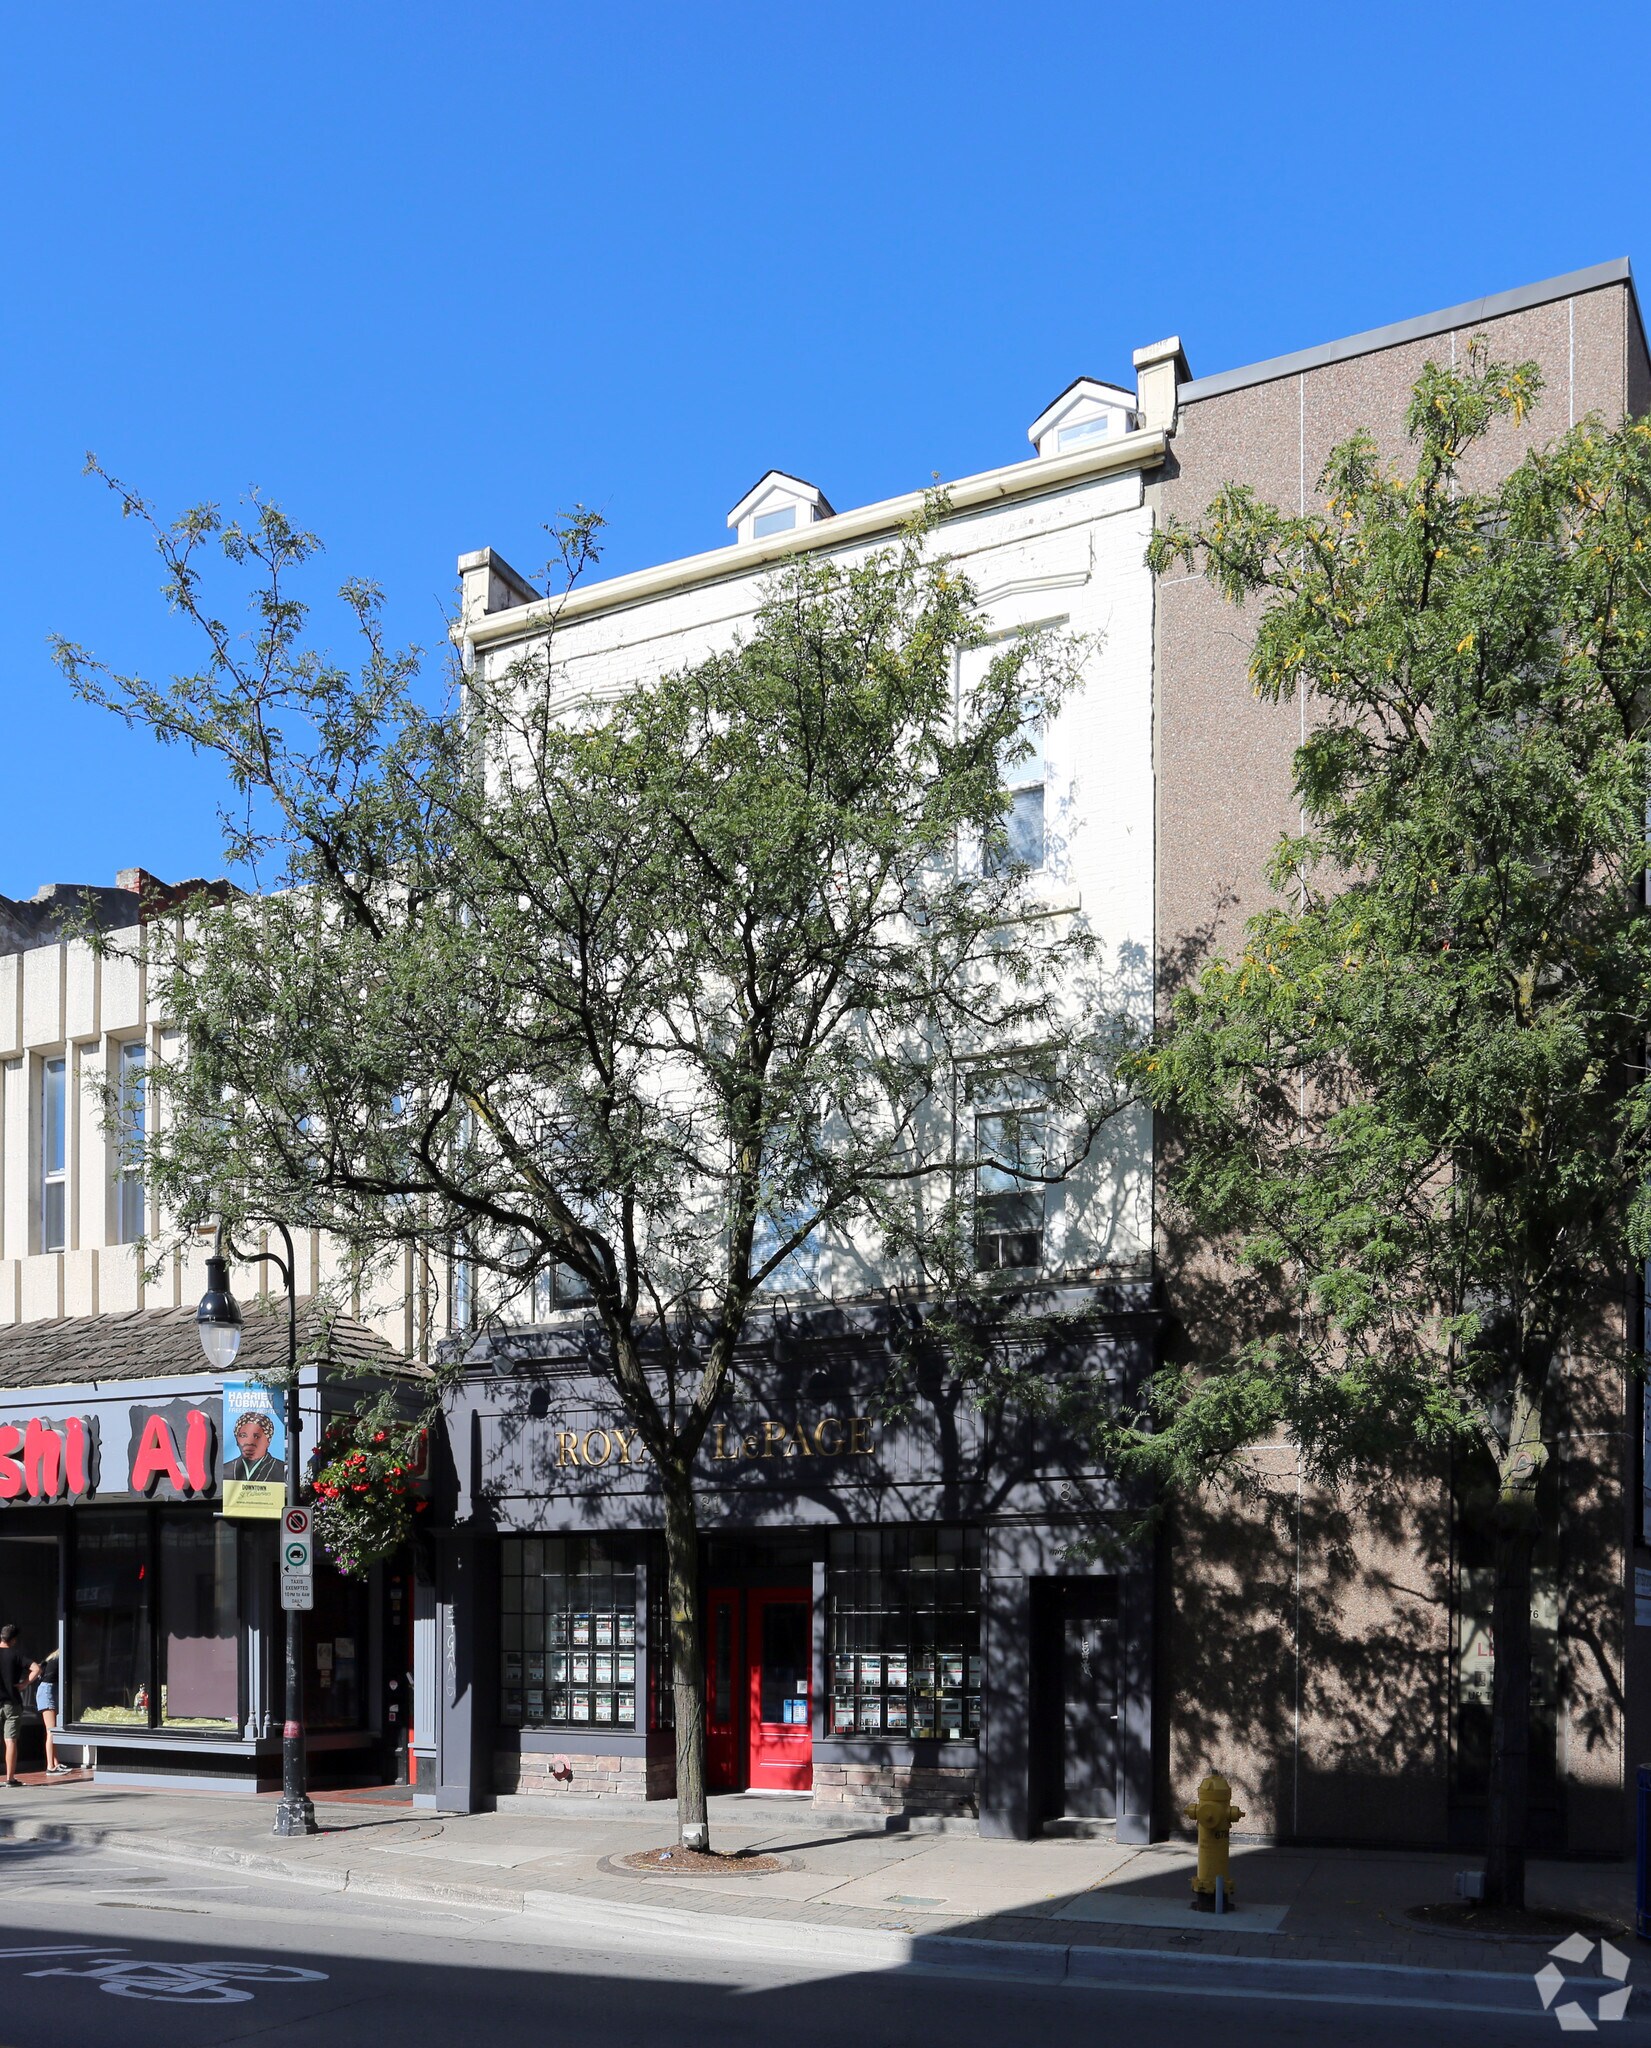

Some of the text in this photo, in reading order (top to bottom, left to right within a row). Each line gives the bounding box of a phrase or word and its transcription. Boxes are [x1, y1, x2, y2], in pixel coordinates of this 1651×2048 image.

[228, 1391, 274, 1400] HARRIET
[228, 1400, 274, 1409] TUBMAN
[711, 1416, 877, 1460] LePAGE
